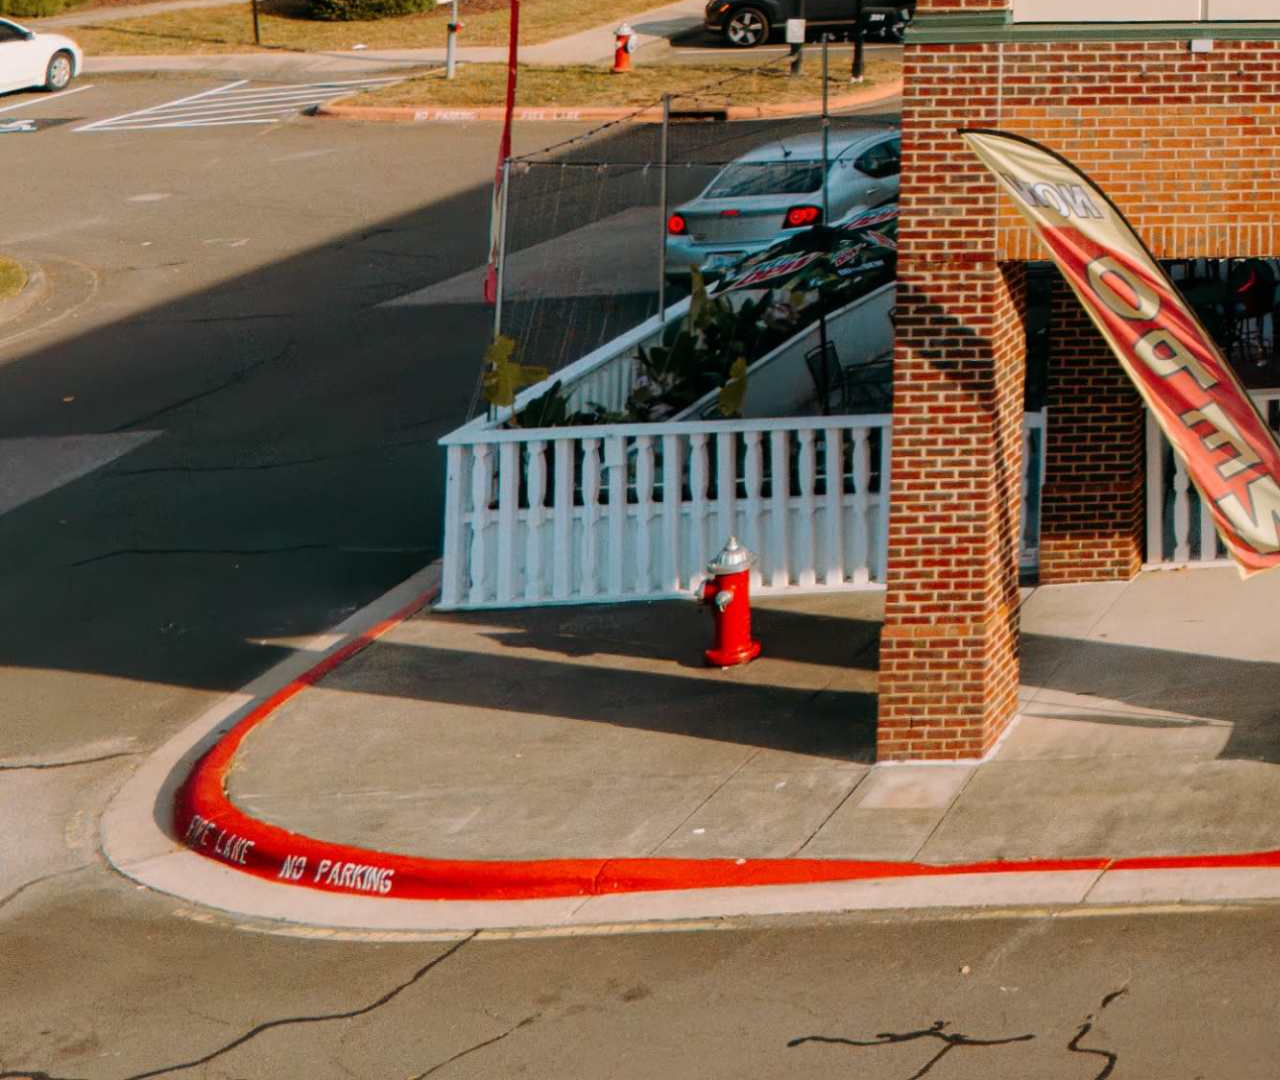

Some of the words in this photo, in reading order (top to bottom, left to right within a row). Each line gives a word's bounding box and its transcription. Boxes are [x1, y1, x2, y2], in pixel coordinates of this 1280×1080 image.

[214, 829, 255, 865] LANE
[278, 855, 307, 881] NO
[314, 859, 395, 894] PARKING
